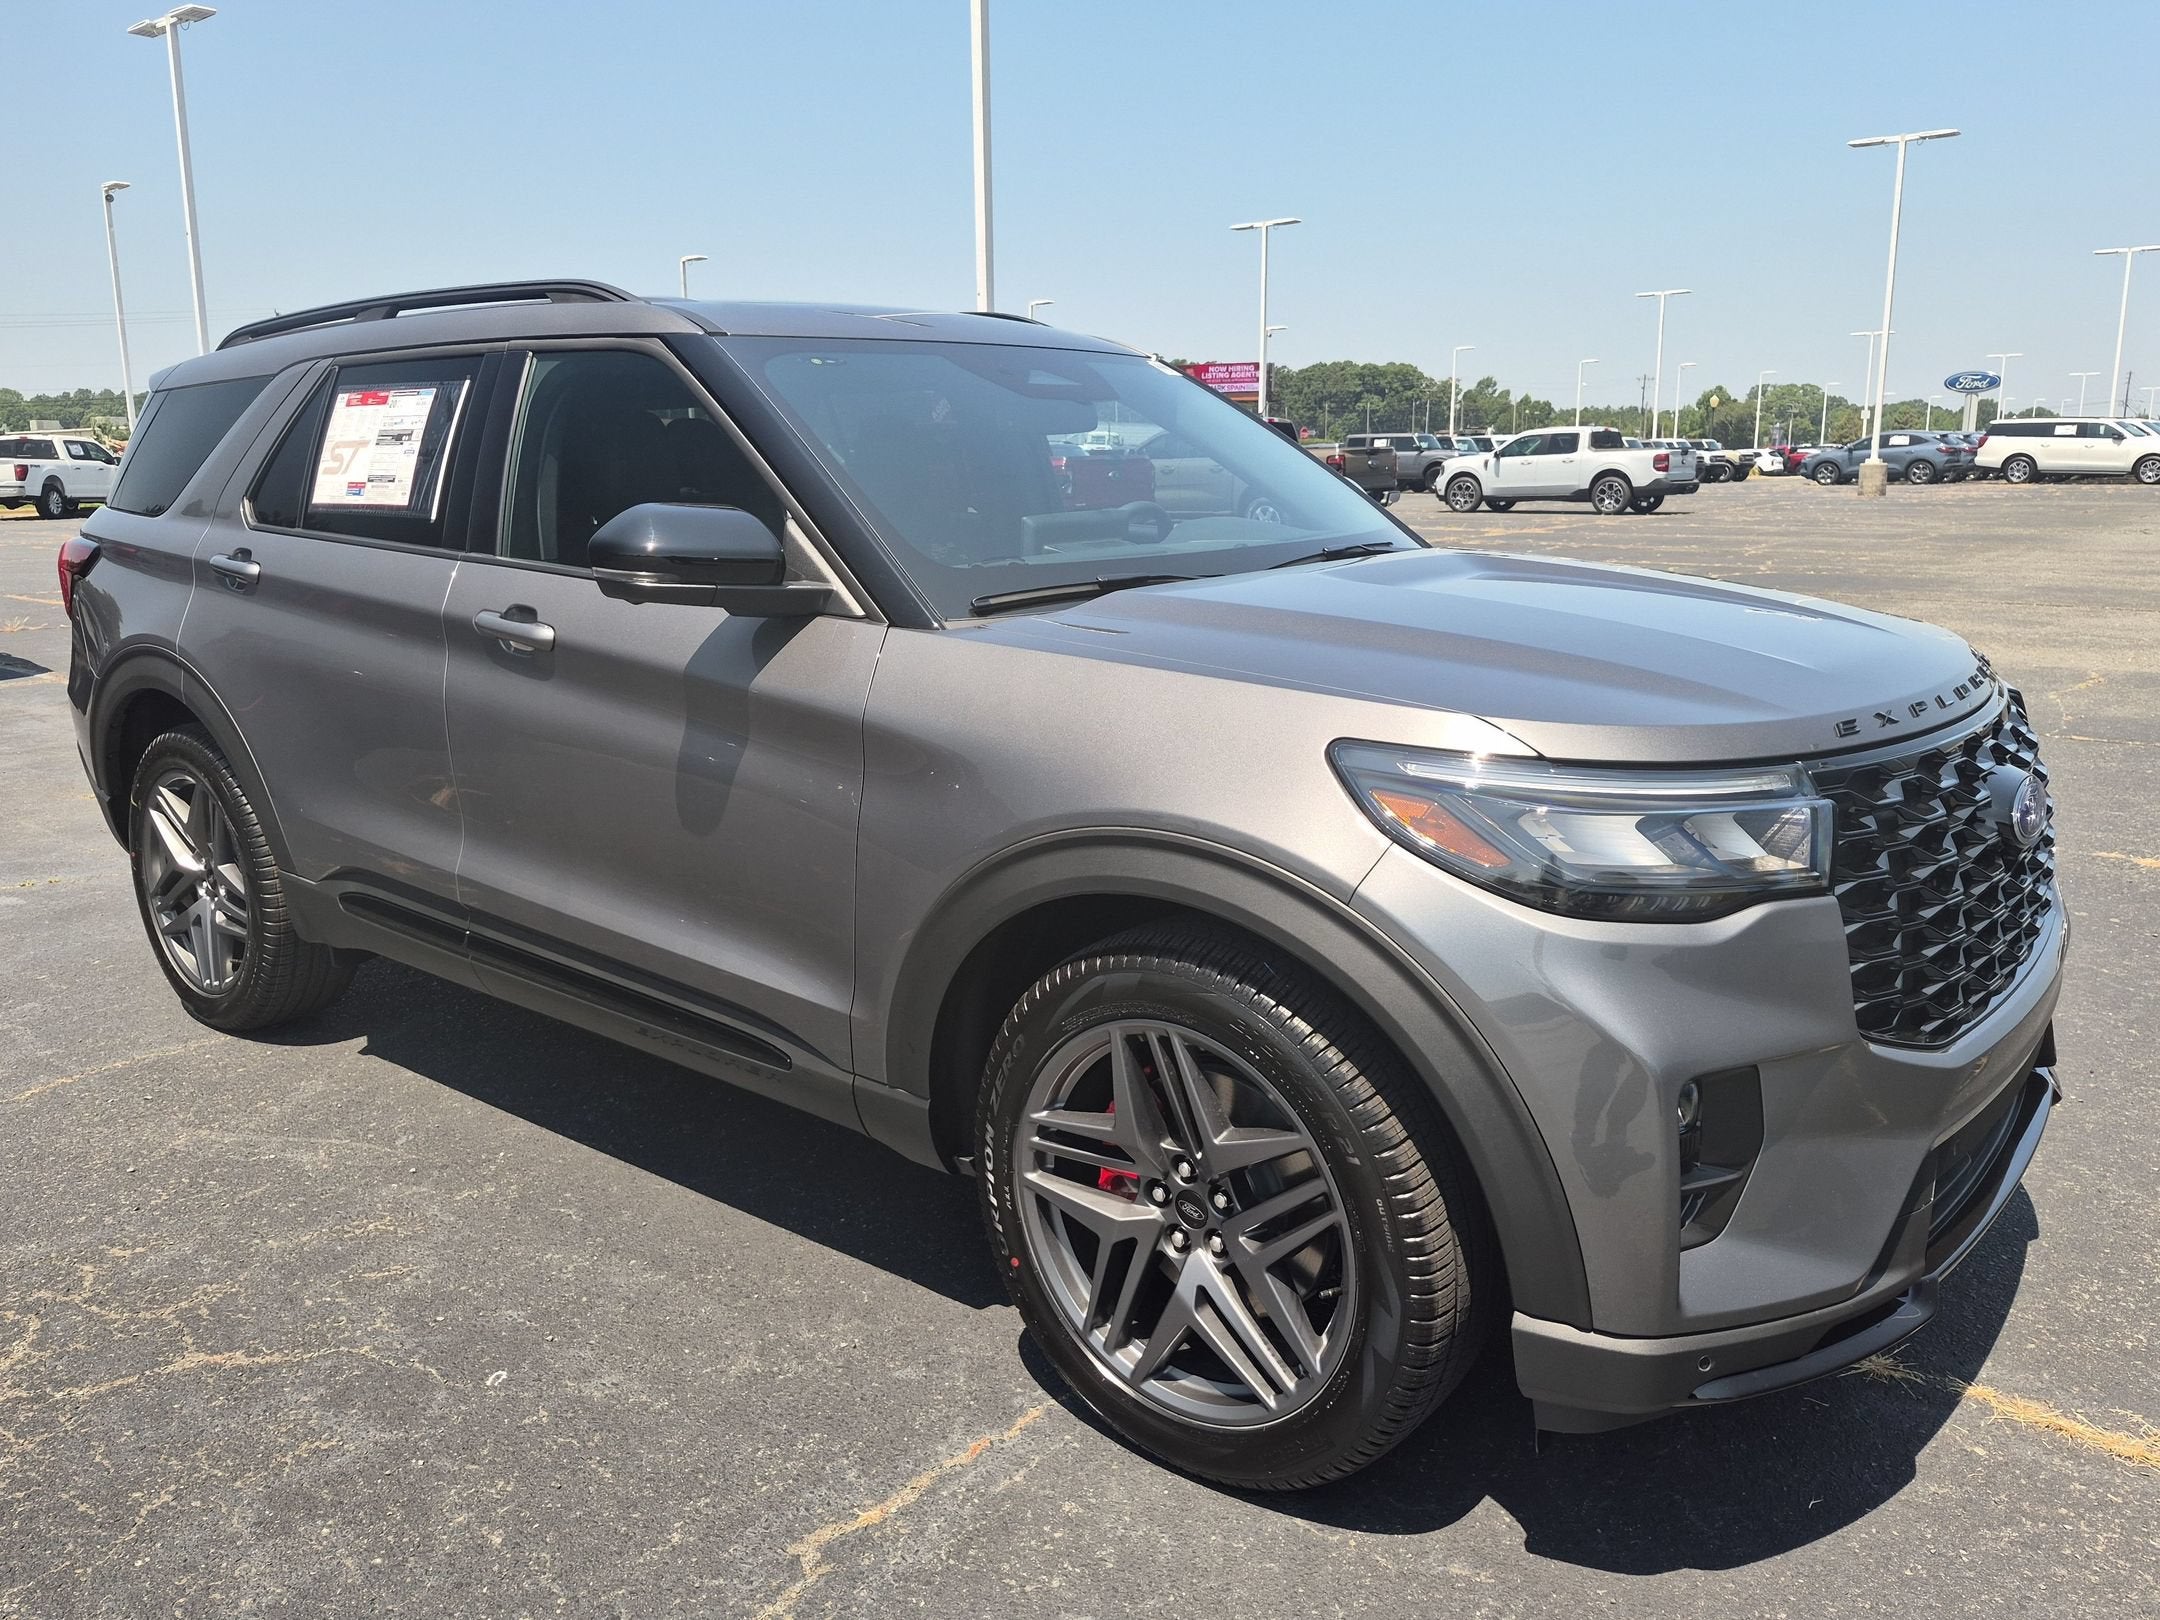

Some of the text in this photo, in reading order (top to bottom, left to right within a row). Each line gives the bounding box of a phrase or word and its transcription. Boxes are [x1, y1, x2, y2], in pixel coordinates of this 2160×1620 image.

[321, 439, 370, 475] ST
[989, 1033, 1025, 1116] ZERO
[1375, 1198, 1395, 1252] OUTSIDE
